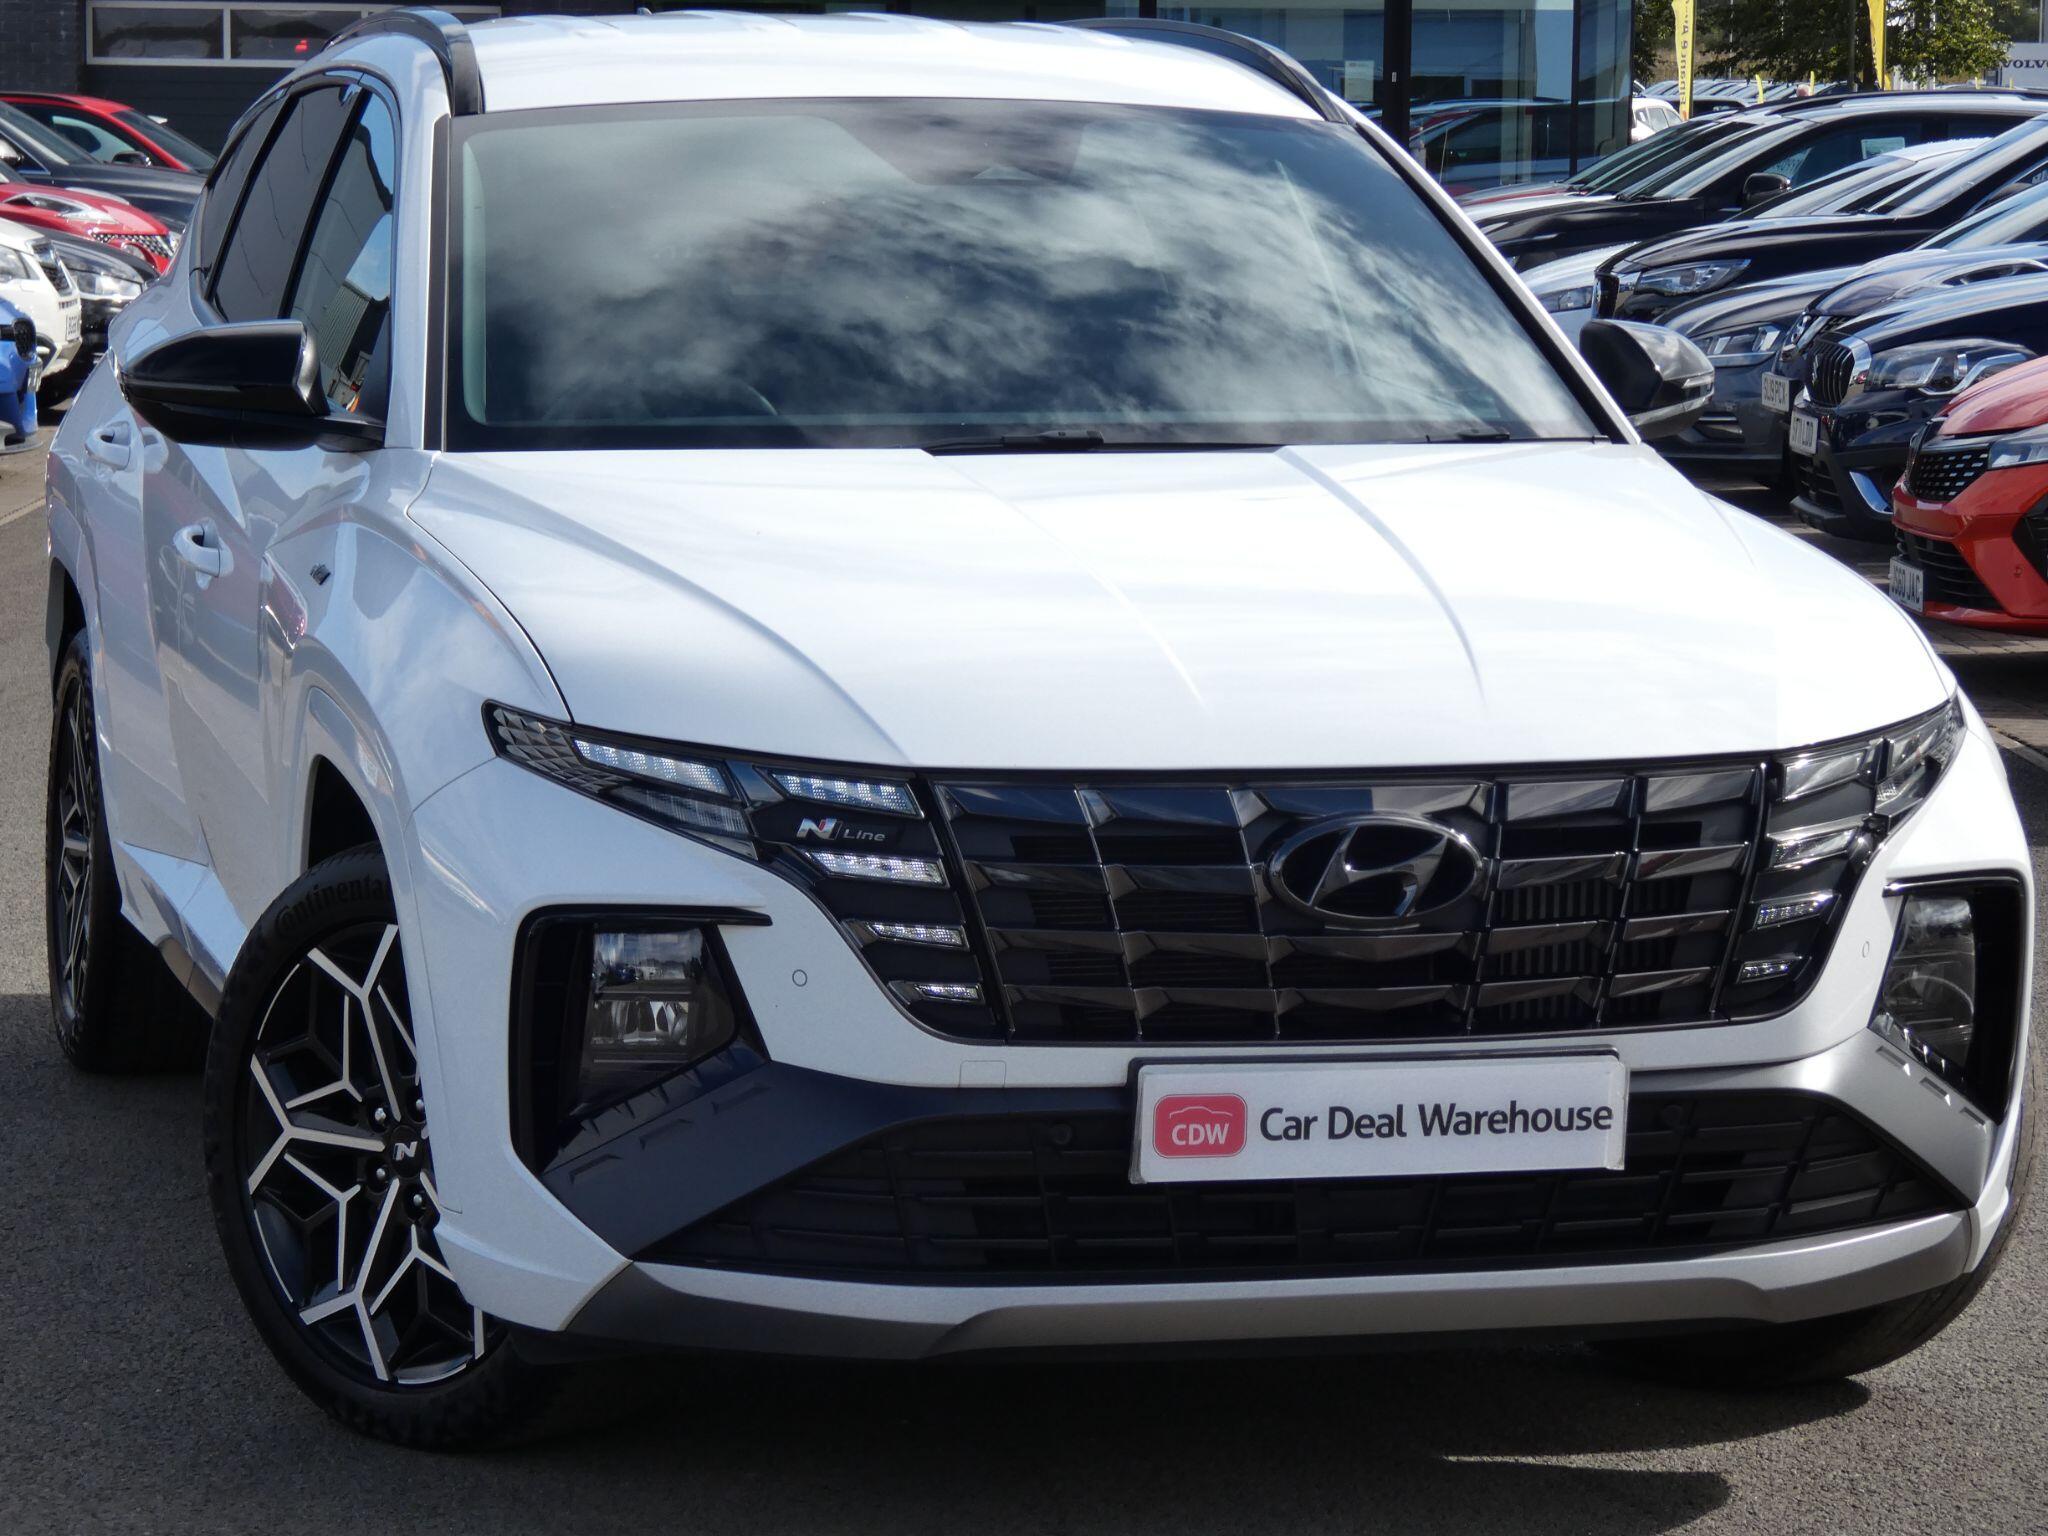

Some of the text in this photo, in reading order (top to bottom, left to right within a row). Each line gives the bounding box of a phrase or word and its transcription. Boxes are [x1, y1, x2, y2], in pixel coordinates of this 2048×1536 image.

[2001, 59, 2048, 69] VOLV
[844, 828, 886, 842] Line
[1260, 1100, 1614, 1142] Car Deal Warehouse
[1171, 1122, 1229, 1146] CDW
